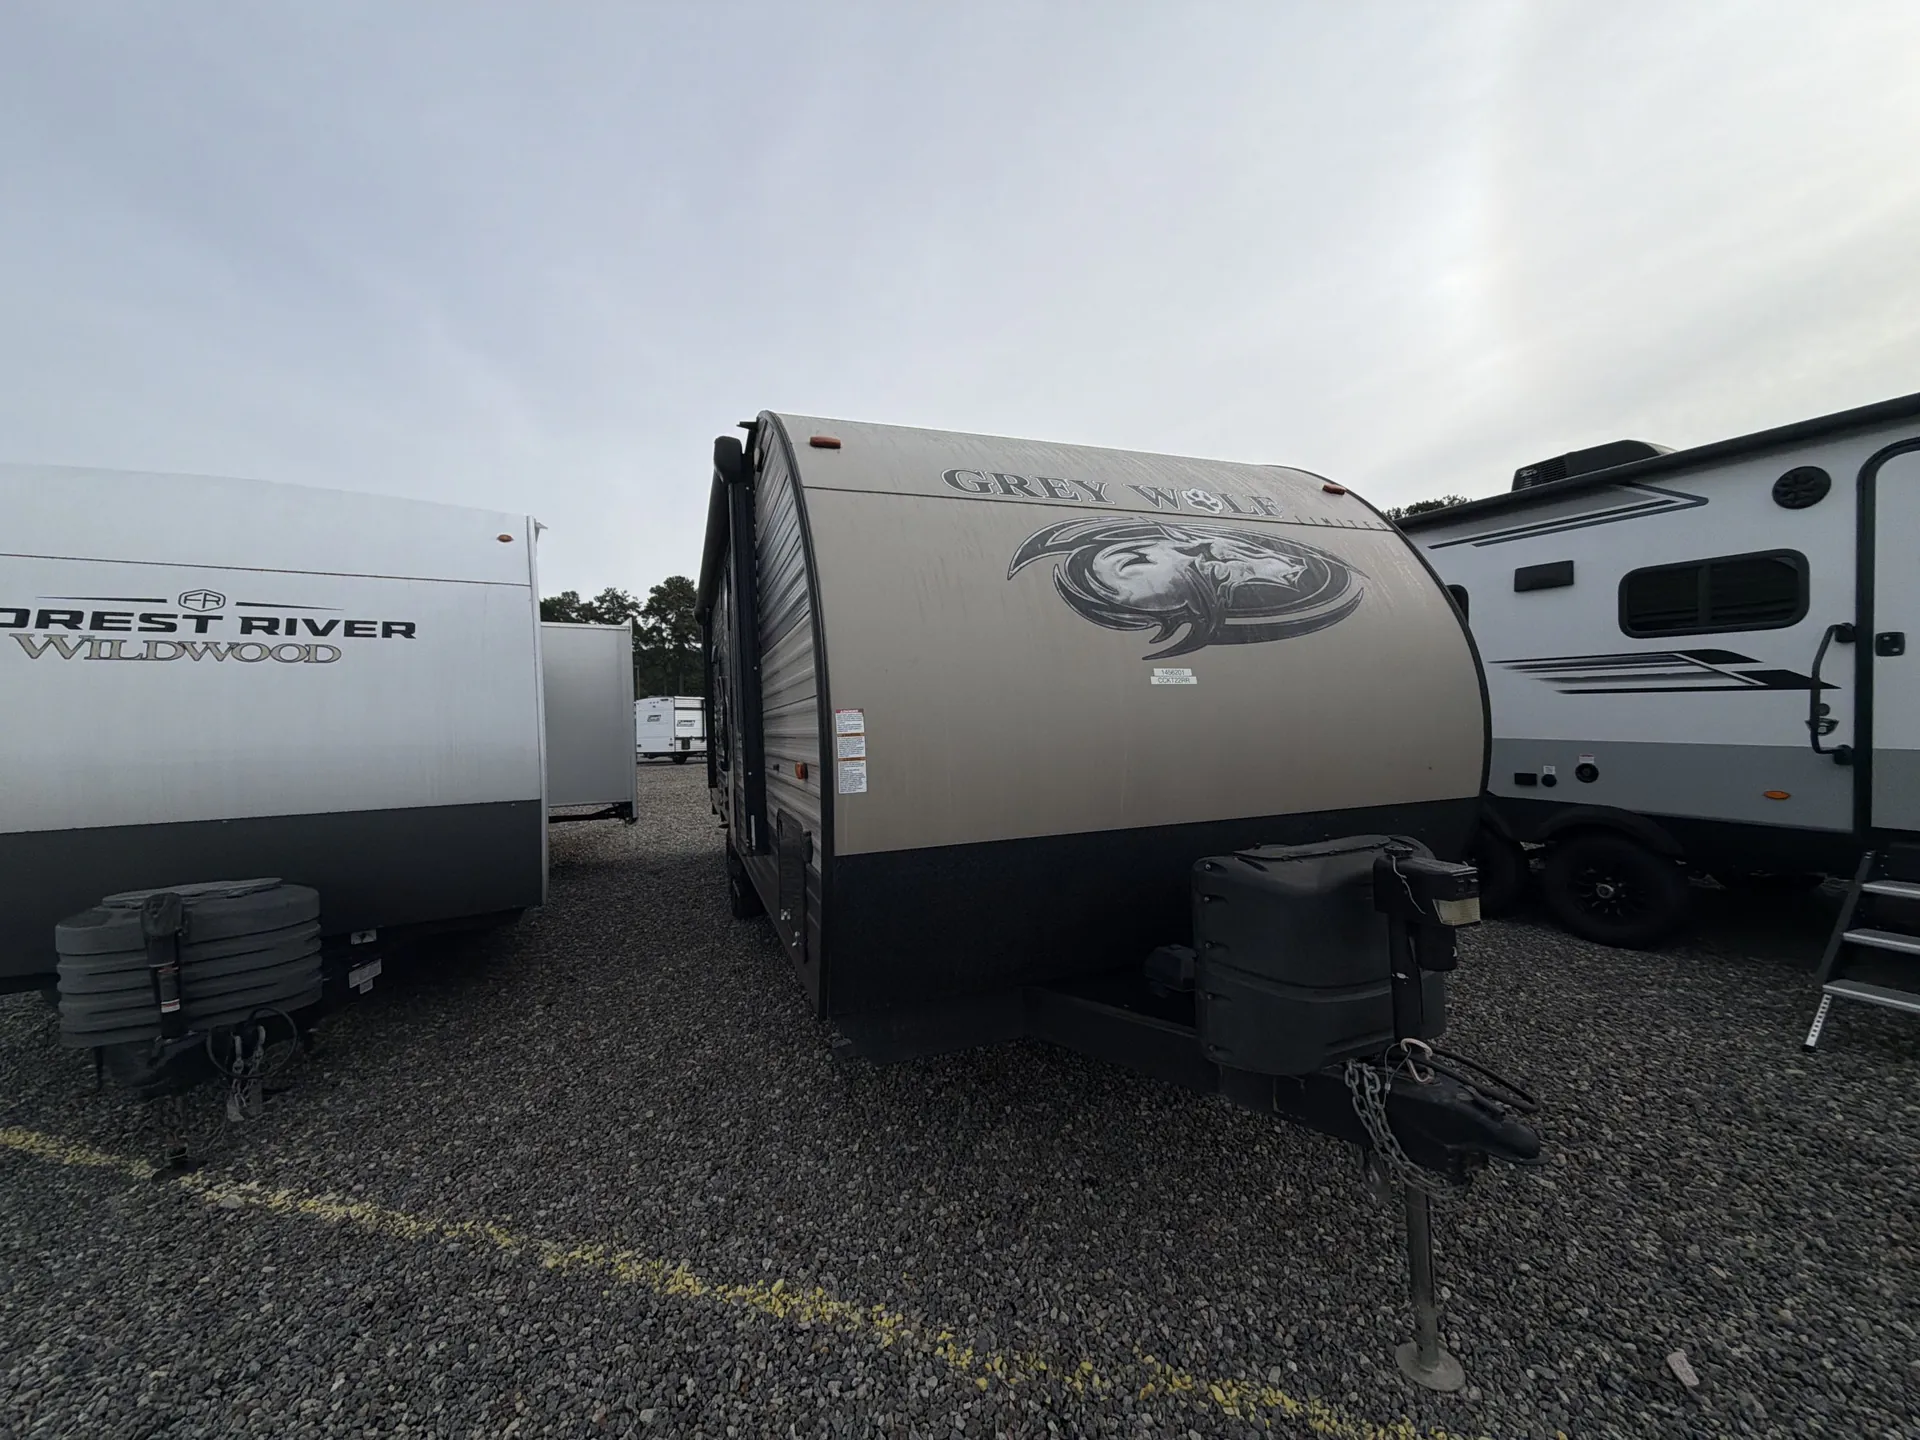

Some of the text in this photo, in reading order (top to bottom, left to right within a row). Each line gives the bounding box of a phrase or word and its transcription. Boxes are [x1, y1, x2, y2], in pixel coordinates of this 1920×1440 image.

[942, 468, 1115, 505] GREY
[238, 616, 417, 639] RIVER
[9, 633, 342, 663] WILDWOOD
